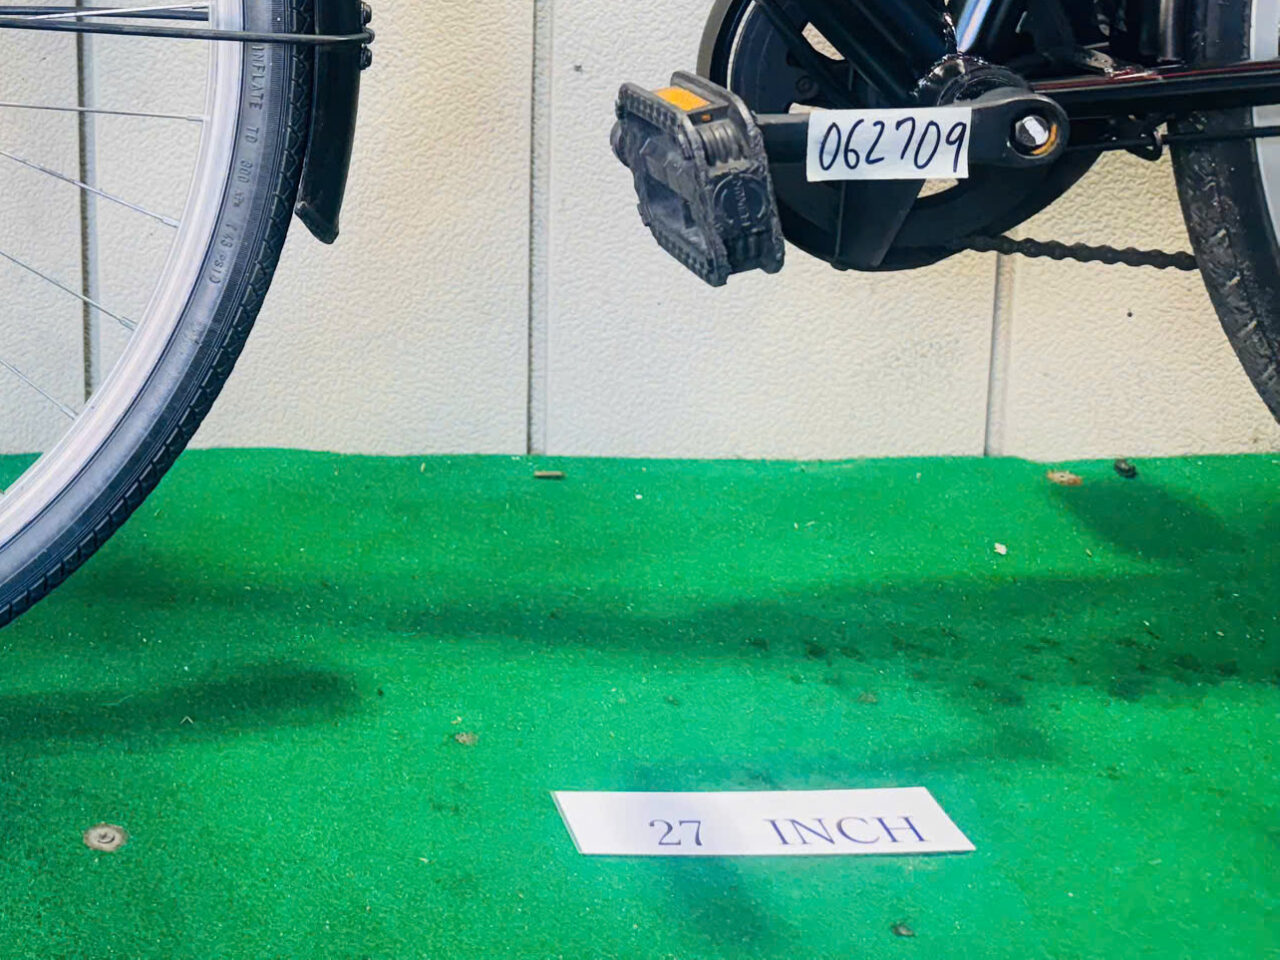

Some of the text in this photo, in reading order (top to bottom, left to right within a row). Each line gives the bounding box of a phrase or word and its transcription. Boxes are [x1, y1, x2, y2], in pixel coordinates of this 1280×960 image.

[248, 45, 266, 111] INFLATE
[244, 126, 260, 144] TO
[819, 116, 967, 173] 062709
[648, 815, 932, 847] 27 INCH
